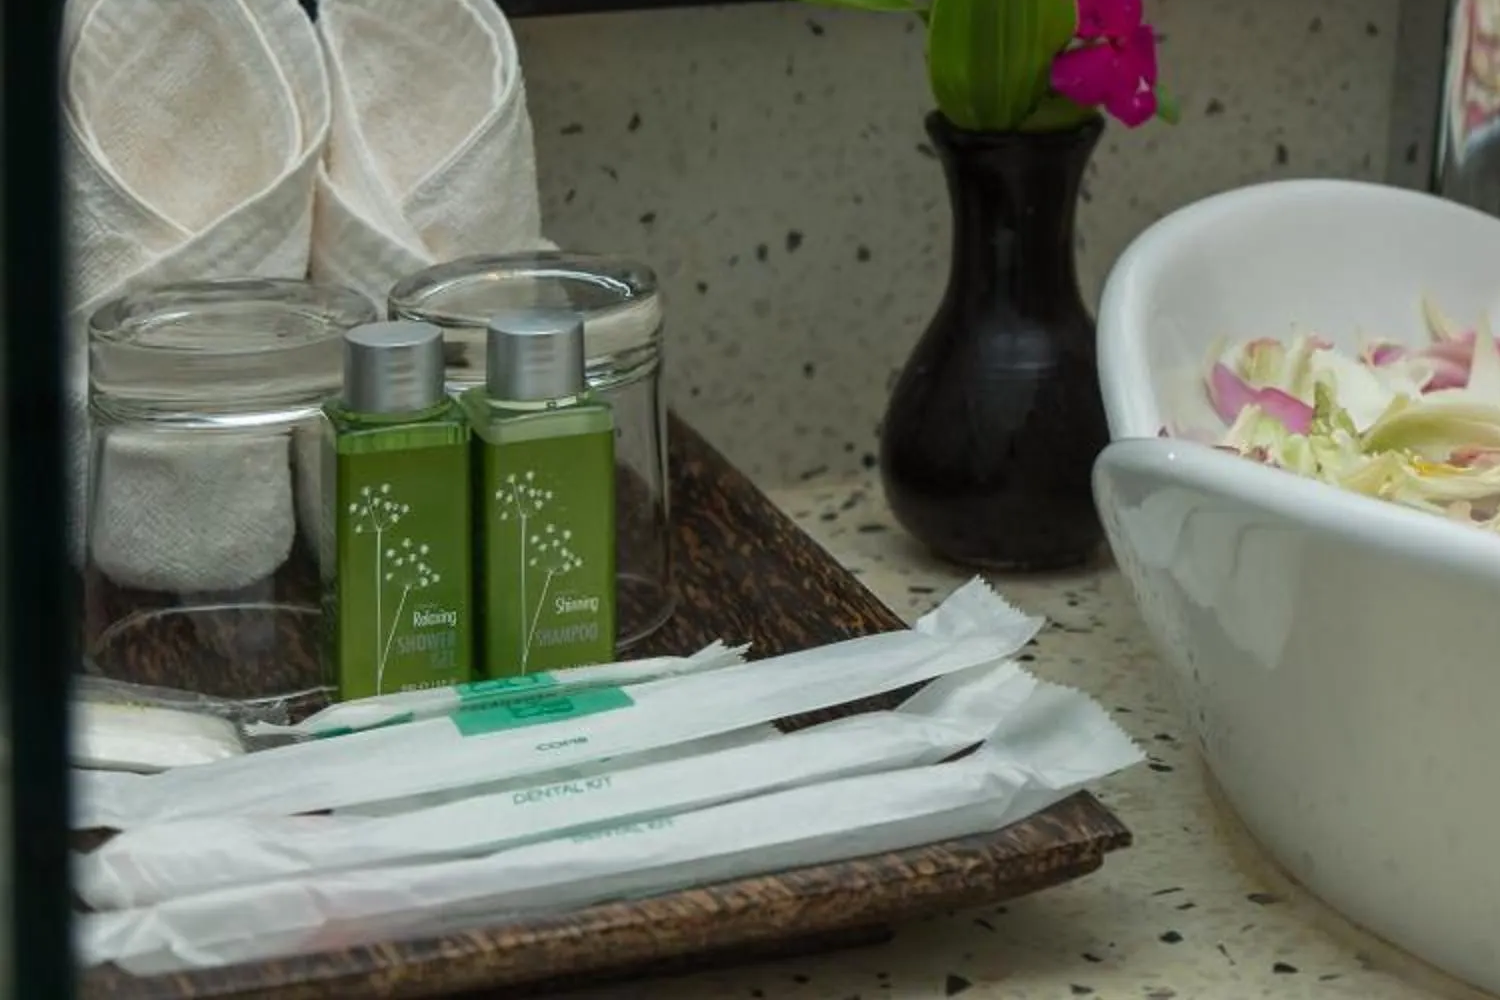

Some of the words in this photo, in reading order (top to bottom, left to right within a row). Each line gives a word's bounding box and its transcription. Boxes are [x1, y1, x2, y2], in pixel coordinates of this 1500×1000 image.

[413, 610, 457, 628] Relaxing
[396, 631, 456, 655] SHOWER
[535, 622, 598, 646] SHAMPOO
[512, 782, 584, 805] DENTAL
[586, 775, 612, 790] KIT
